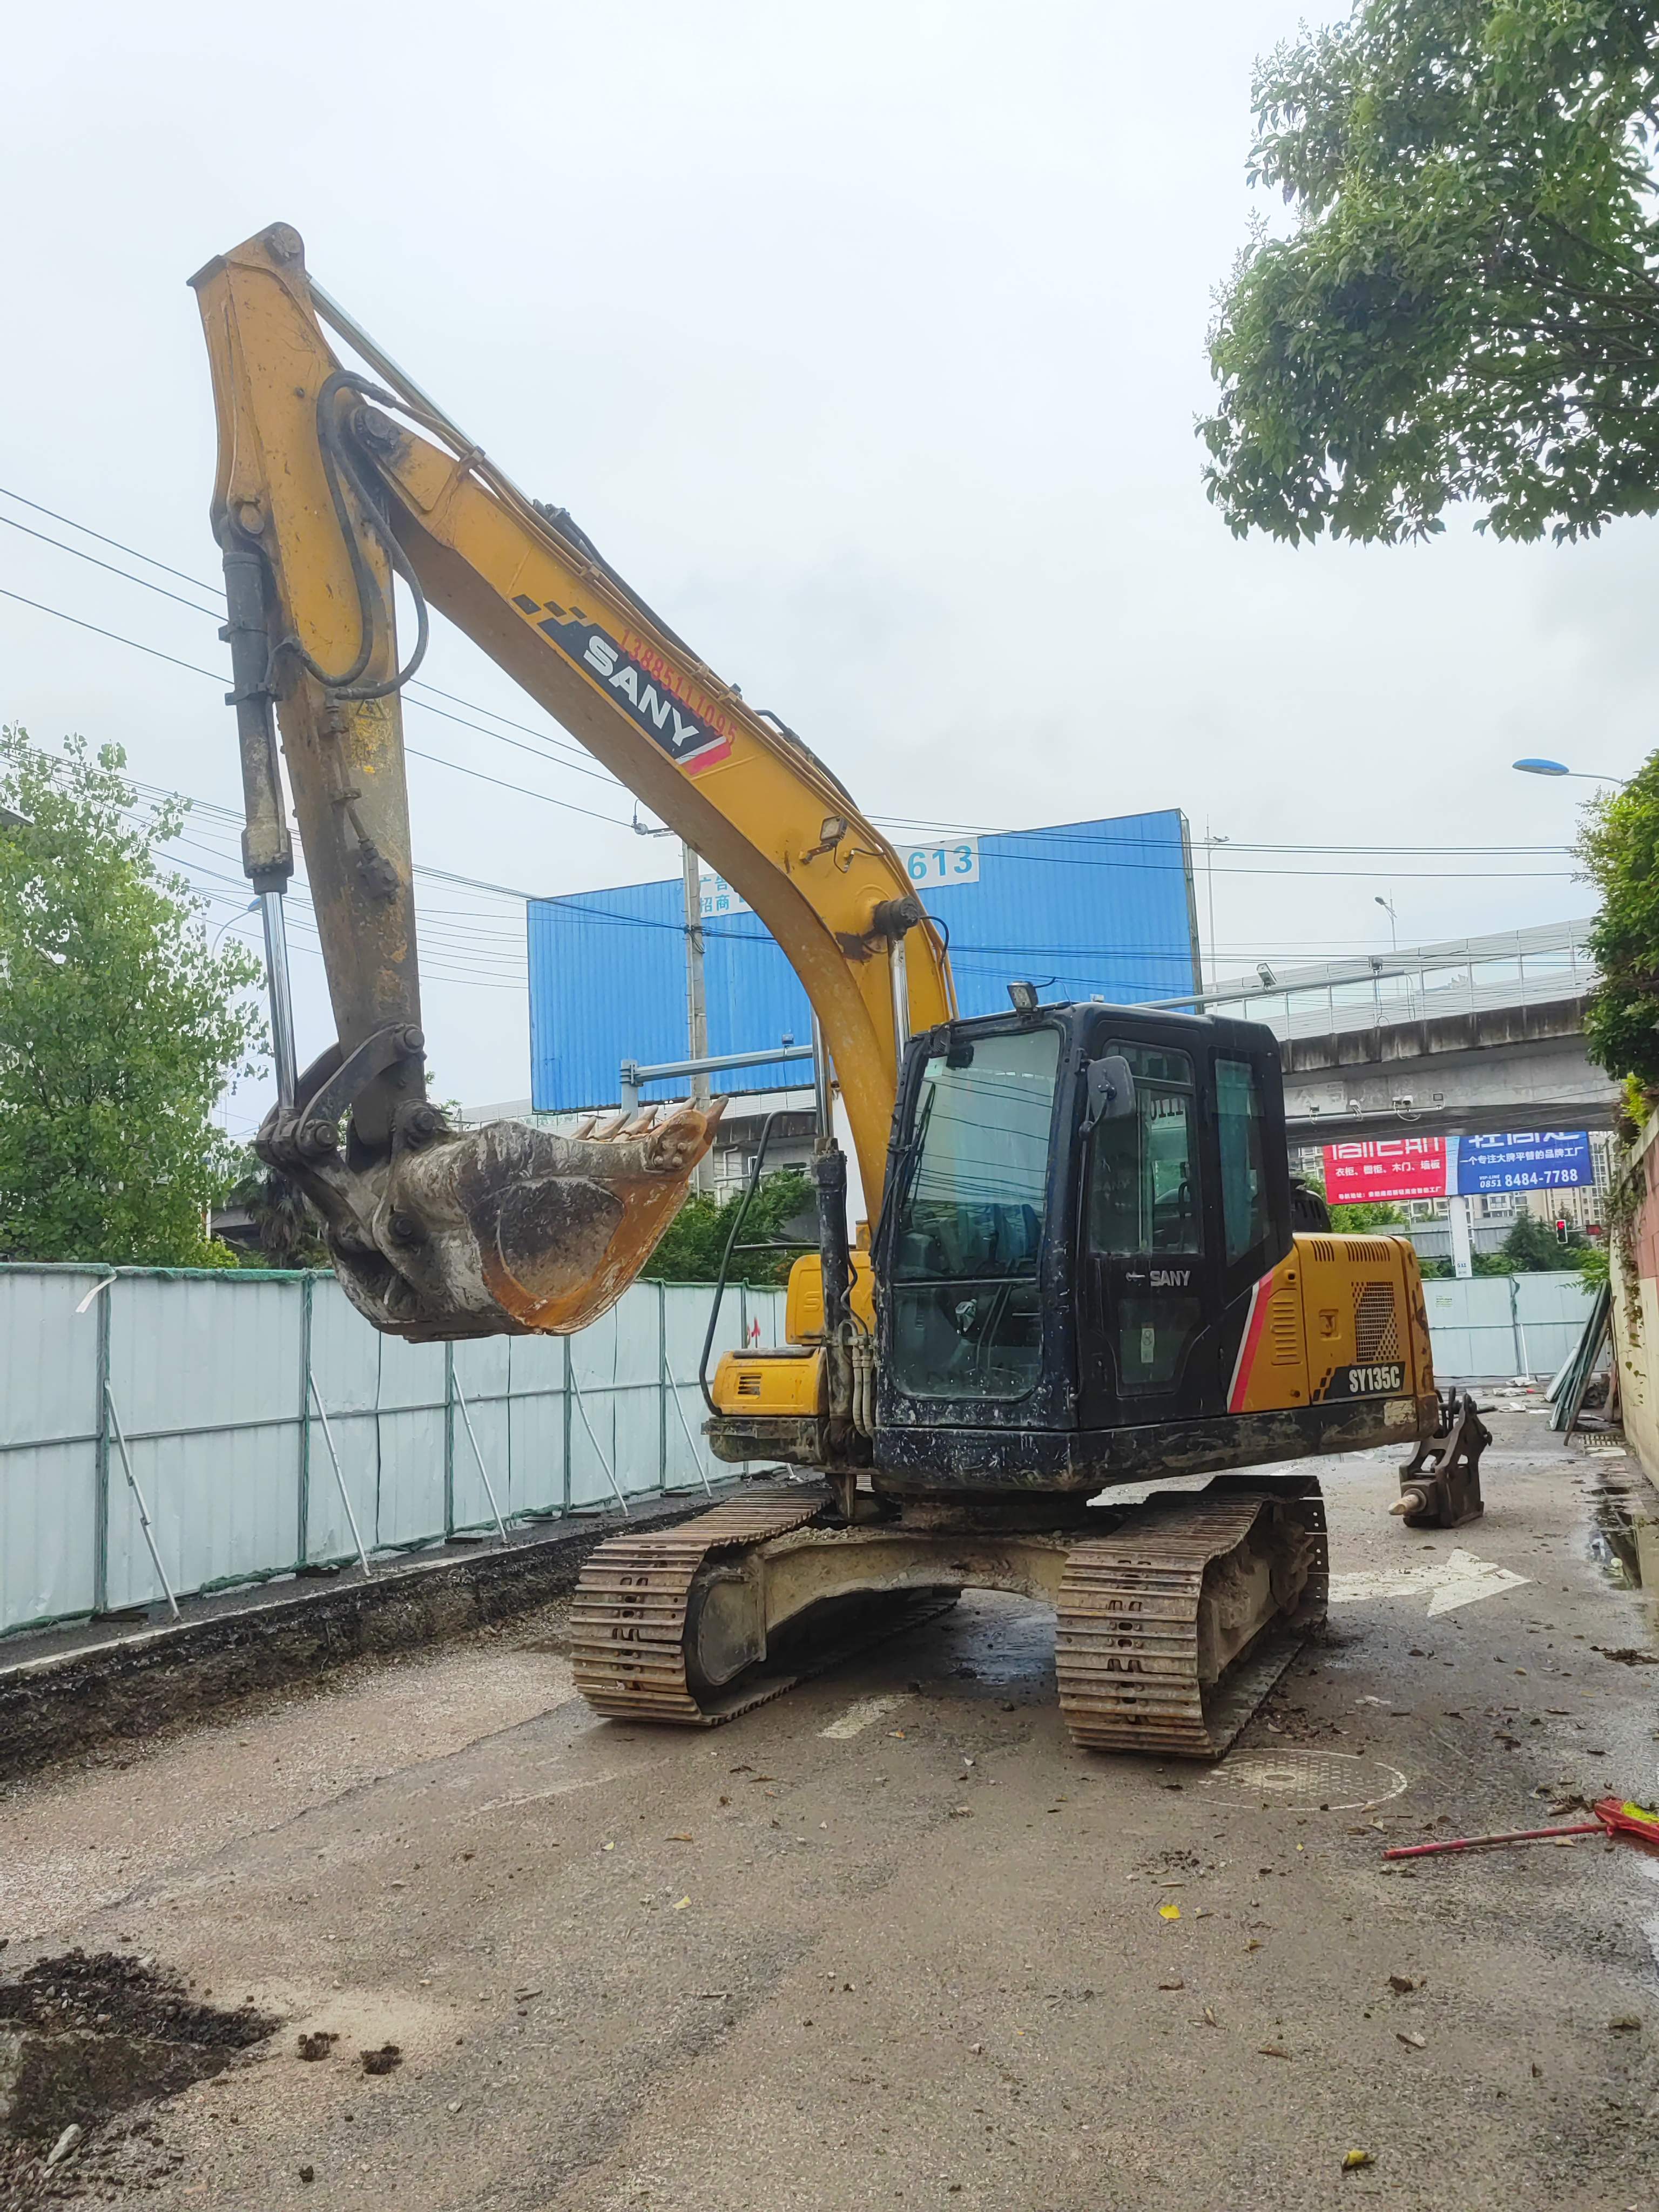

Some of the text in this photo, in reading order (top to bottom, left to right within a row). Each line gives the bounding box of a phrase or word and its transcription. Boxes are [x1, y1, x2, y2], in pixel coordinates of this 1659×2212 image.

[584, 635, 699, 747] SANY
[617, 629, 738, 746] 13885111095
[1459, 1147, 1584, 1165] 一个专注大牌平替的品牌工厂
[1480, 1169, 1578, 1188] 0851 8484-7788
[1150, 1270, 1190, 1287] SANY
[1349, 1366, 1400, 1393] SY135C
